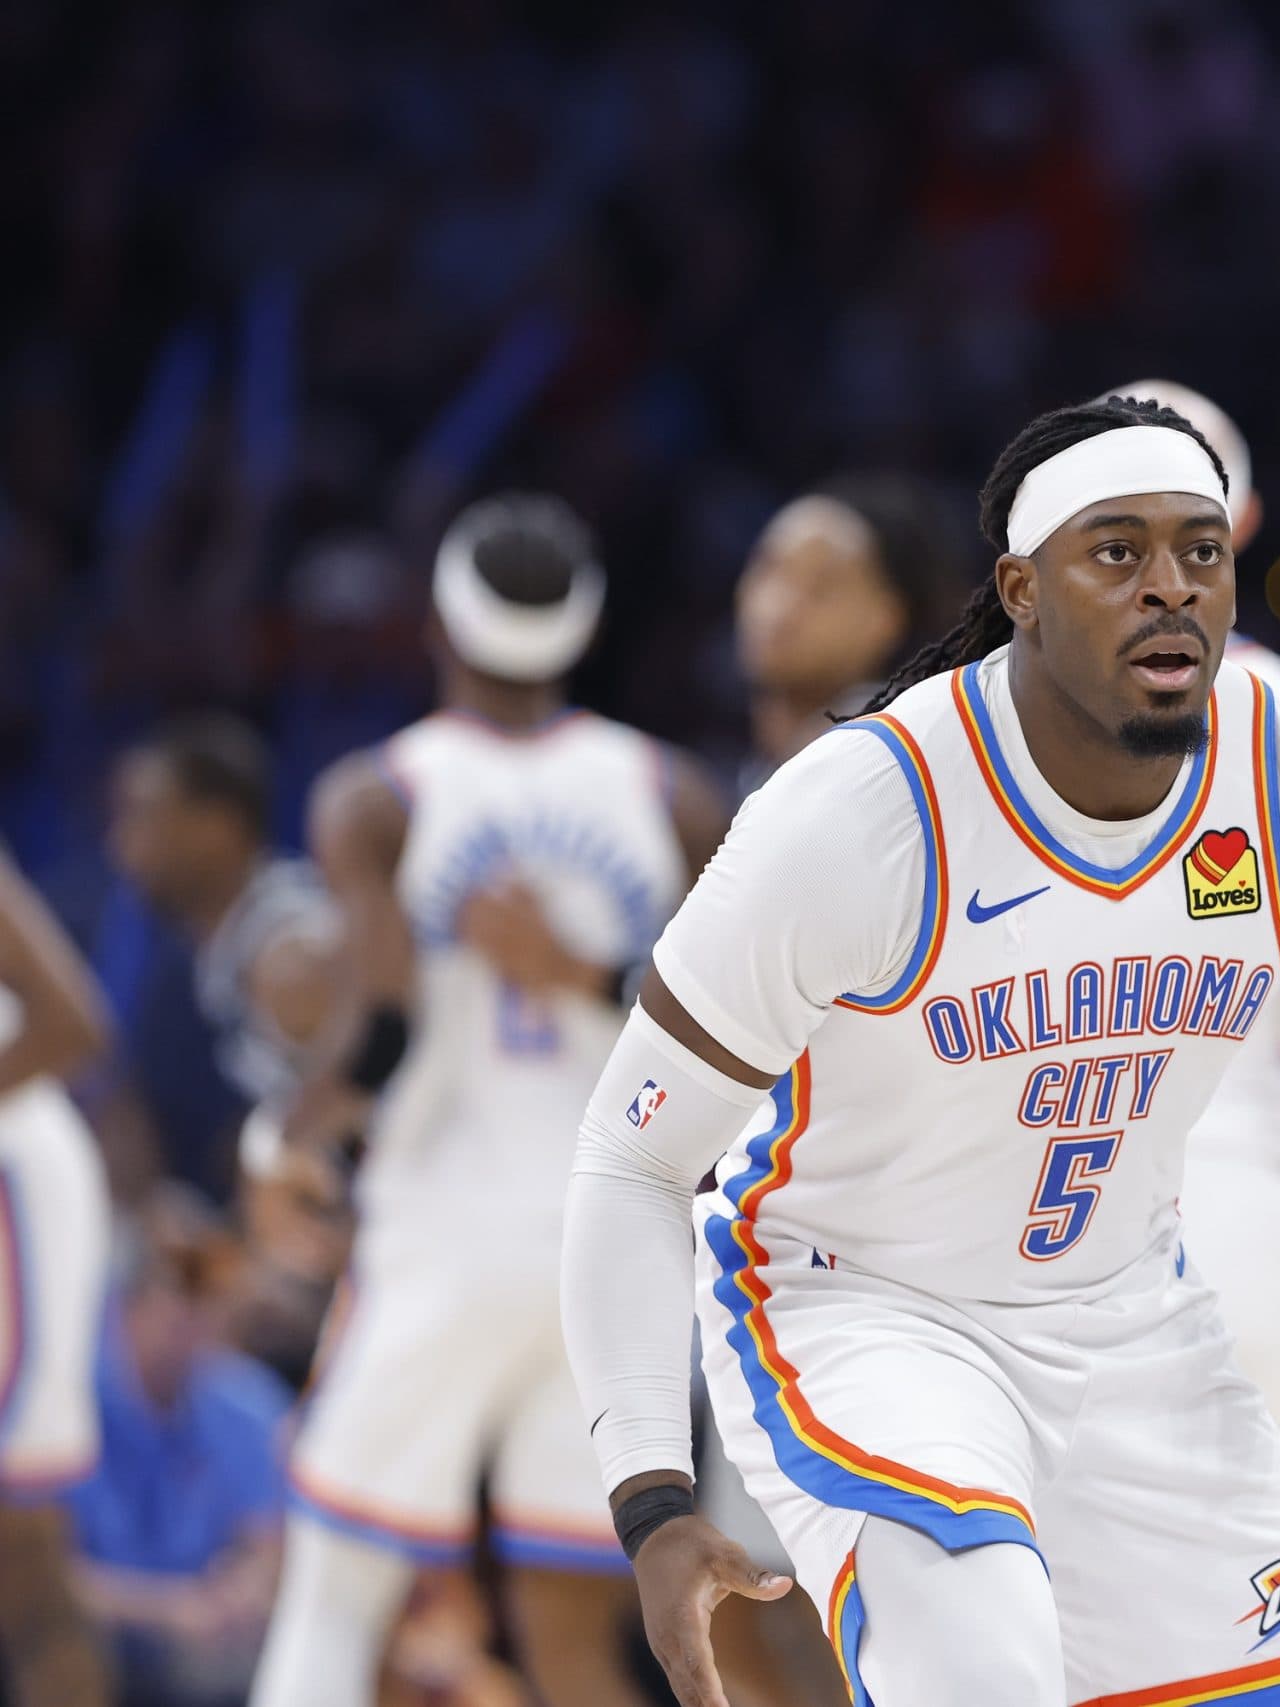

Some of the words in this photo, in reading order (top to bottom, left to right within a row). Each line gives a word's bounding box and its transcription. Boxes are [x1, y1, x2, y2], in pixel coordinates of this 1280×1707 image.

[922, 955, 1274, 1064] OKLAHOMA
[1017, 1048, 1175, 1128] CITY
[1019, 1130, 1124, 1262] 5
